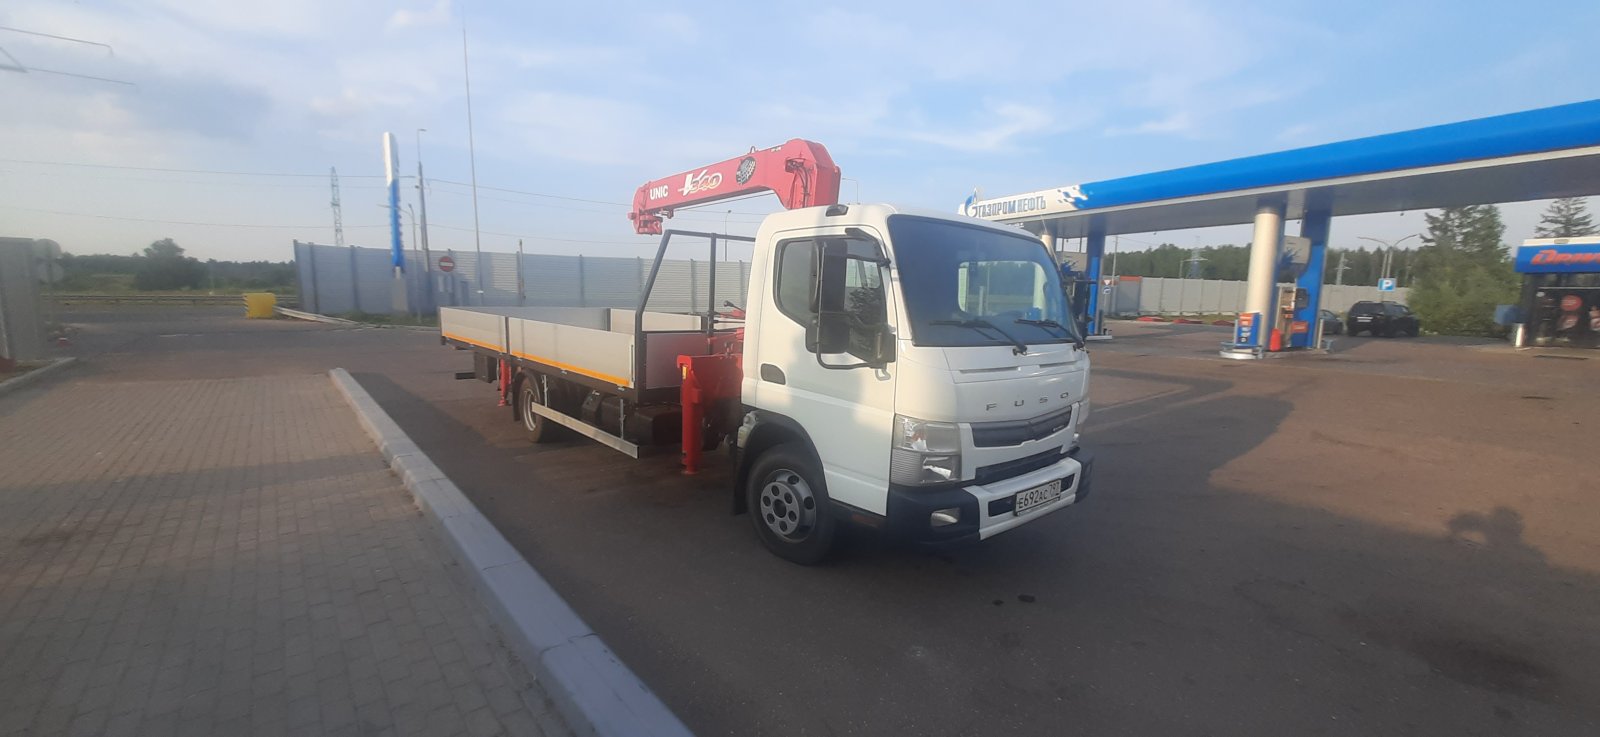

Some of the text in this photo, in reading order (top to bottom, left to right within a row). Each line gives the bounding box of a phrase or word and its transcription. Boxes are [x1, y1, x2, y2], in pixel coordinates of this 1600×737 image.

[649, 185, 669, 200] UNIC
[978, 195, 1047, 218] ГАЗПРОМ НЕФТЬ
[1383, 280, 1393, 290] P
[985, 391, 1069, 411] FUSO
